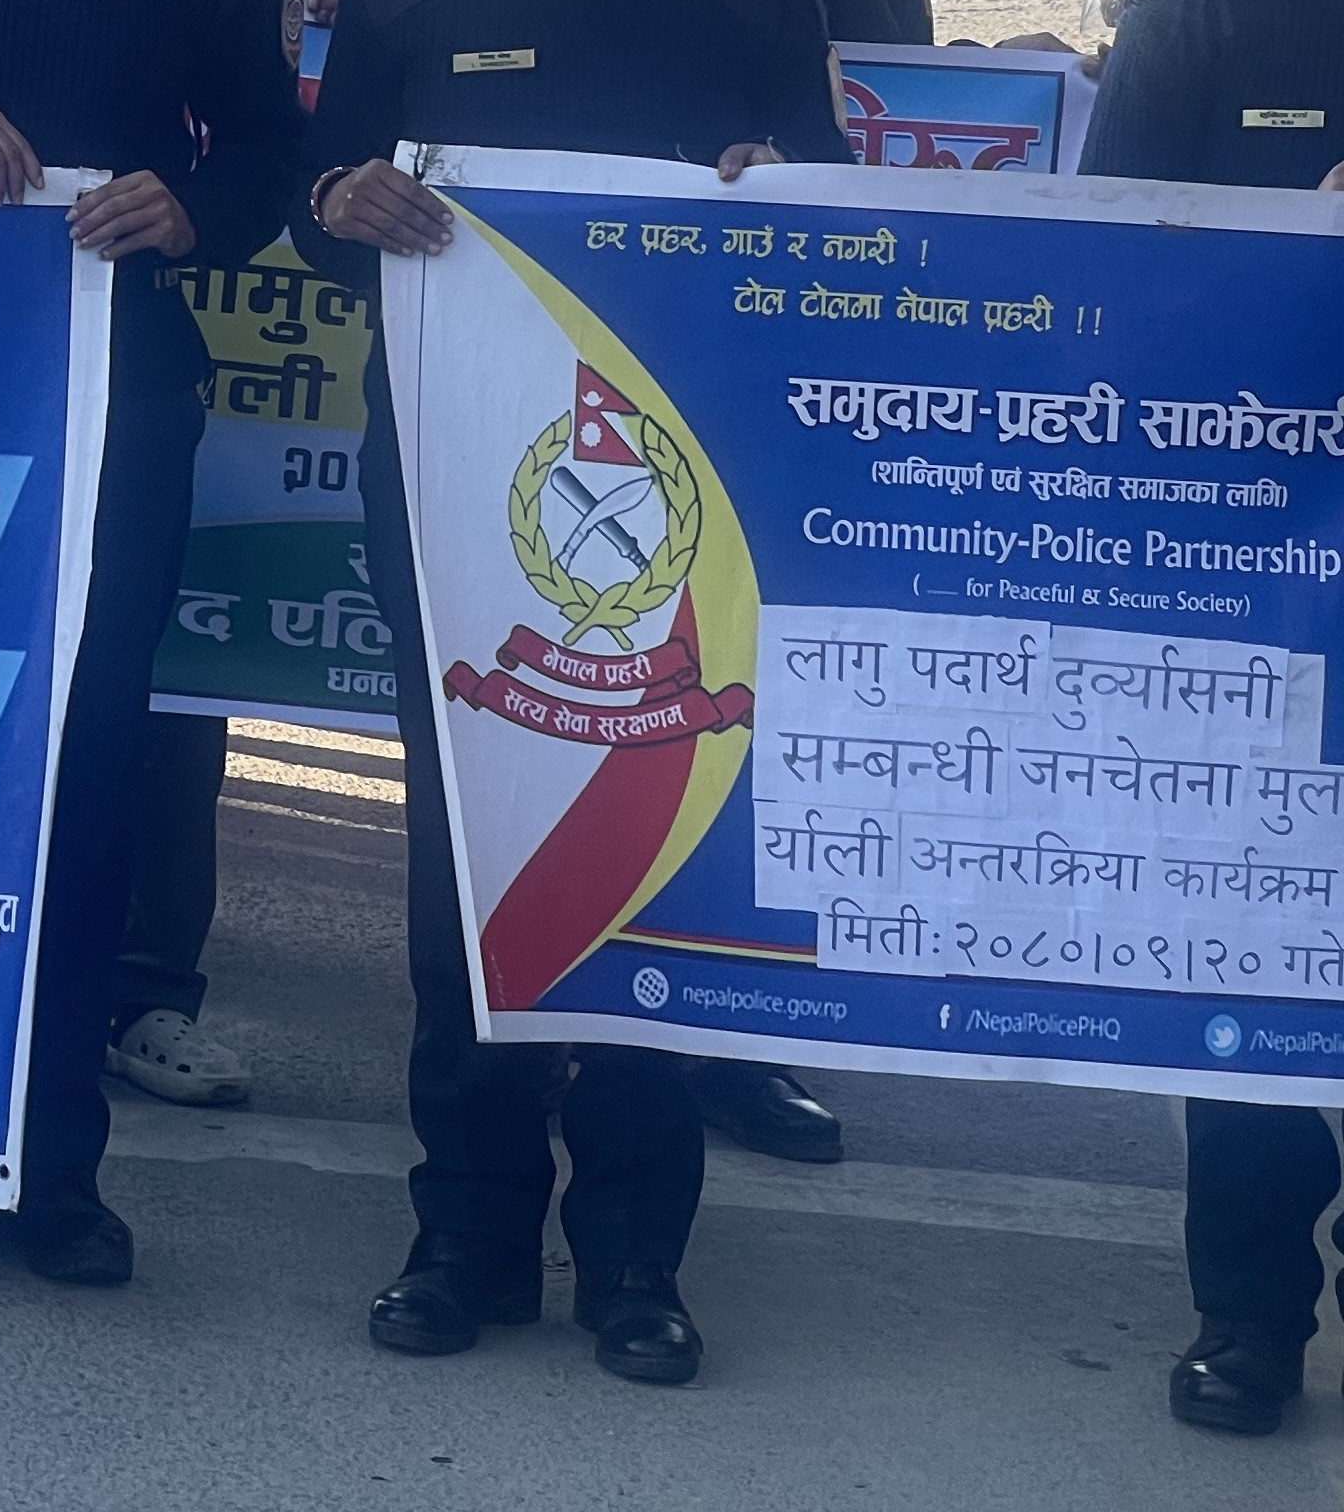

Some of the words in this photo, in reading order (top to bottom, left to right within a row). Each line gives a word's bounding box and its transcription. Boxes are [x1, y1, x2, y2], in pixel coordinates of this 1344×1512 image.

[1176, 590, 1252, 619] Society)
[542, 645, 598, 682] नेपाल
[604, 654, 653, 686] प्रहरी
[782, 636, 888, 708] लागु
[905, 634, 1038, 697] पदार्थ
[504, 687, 549, 725] सत्य
[553, 703, 592, 736] सेवा
[778, 726, 1003, 796] सम्बन्धी
[1016, 735, 1241, 808] जनचेतना
[909, 829, 1147, 892] अन्तरक्रिया
[1160, 845, 1340, 908] कार्यक्रम
[683, 982, 848, 1023] nepalpolice.gov.np
